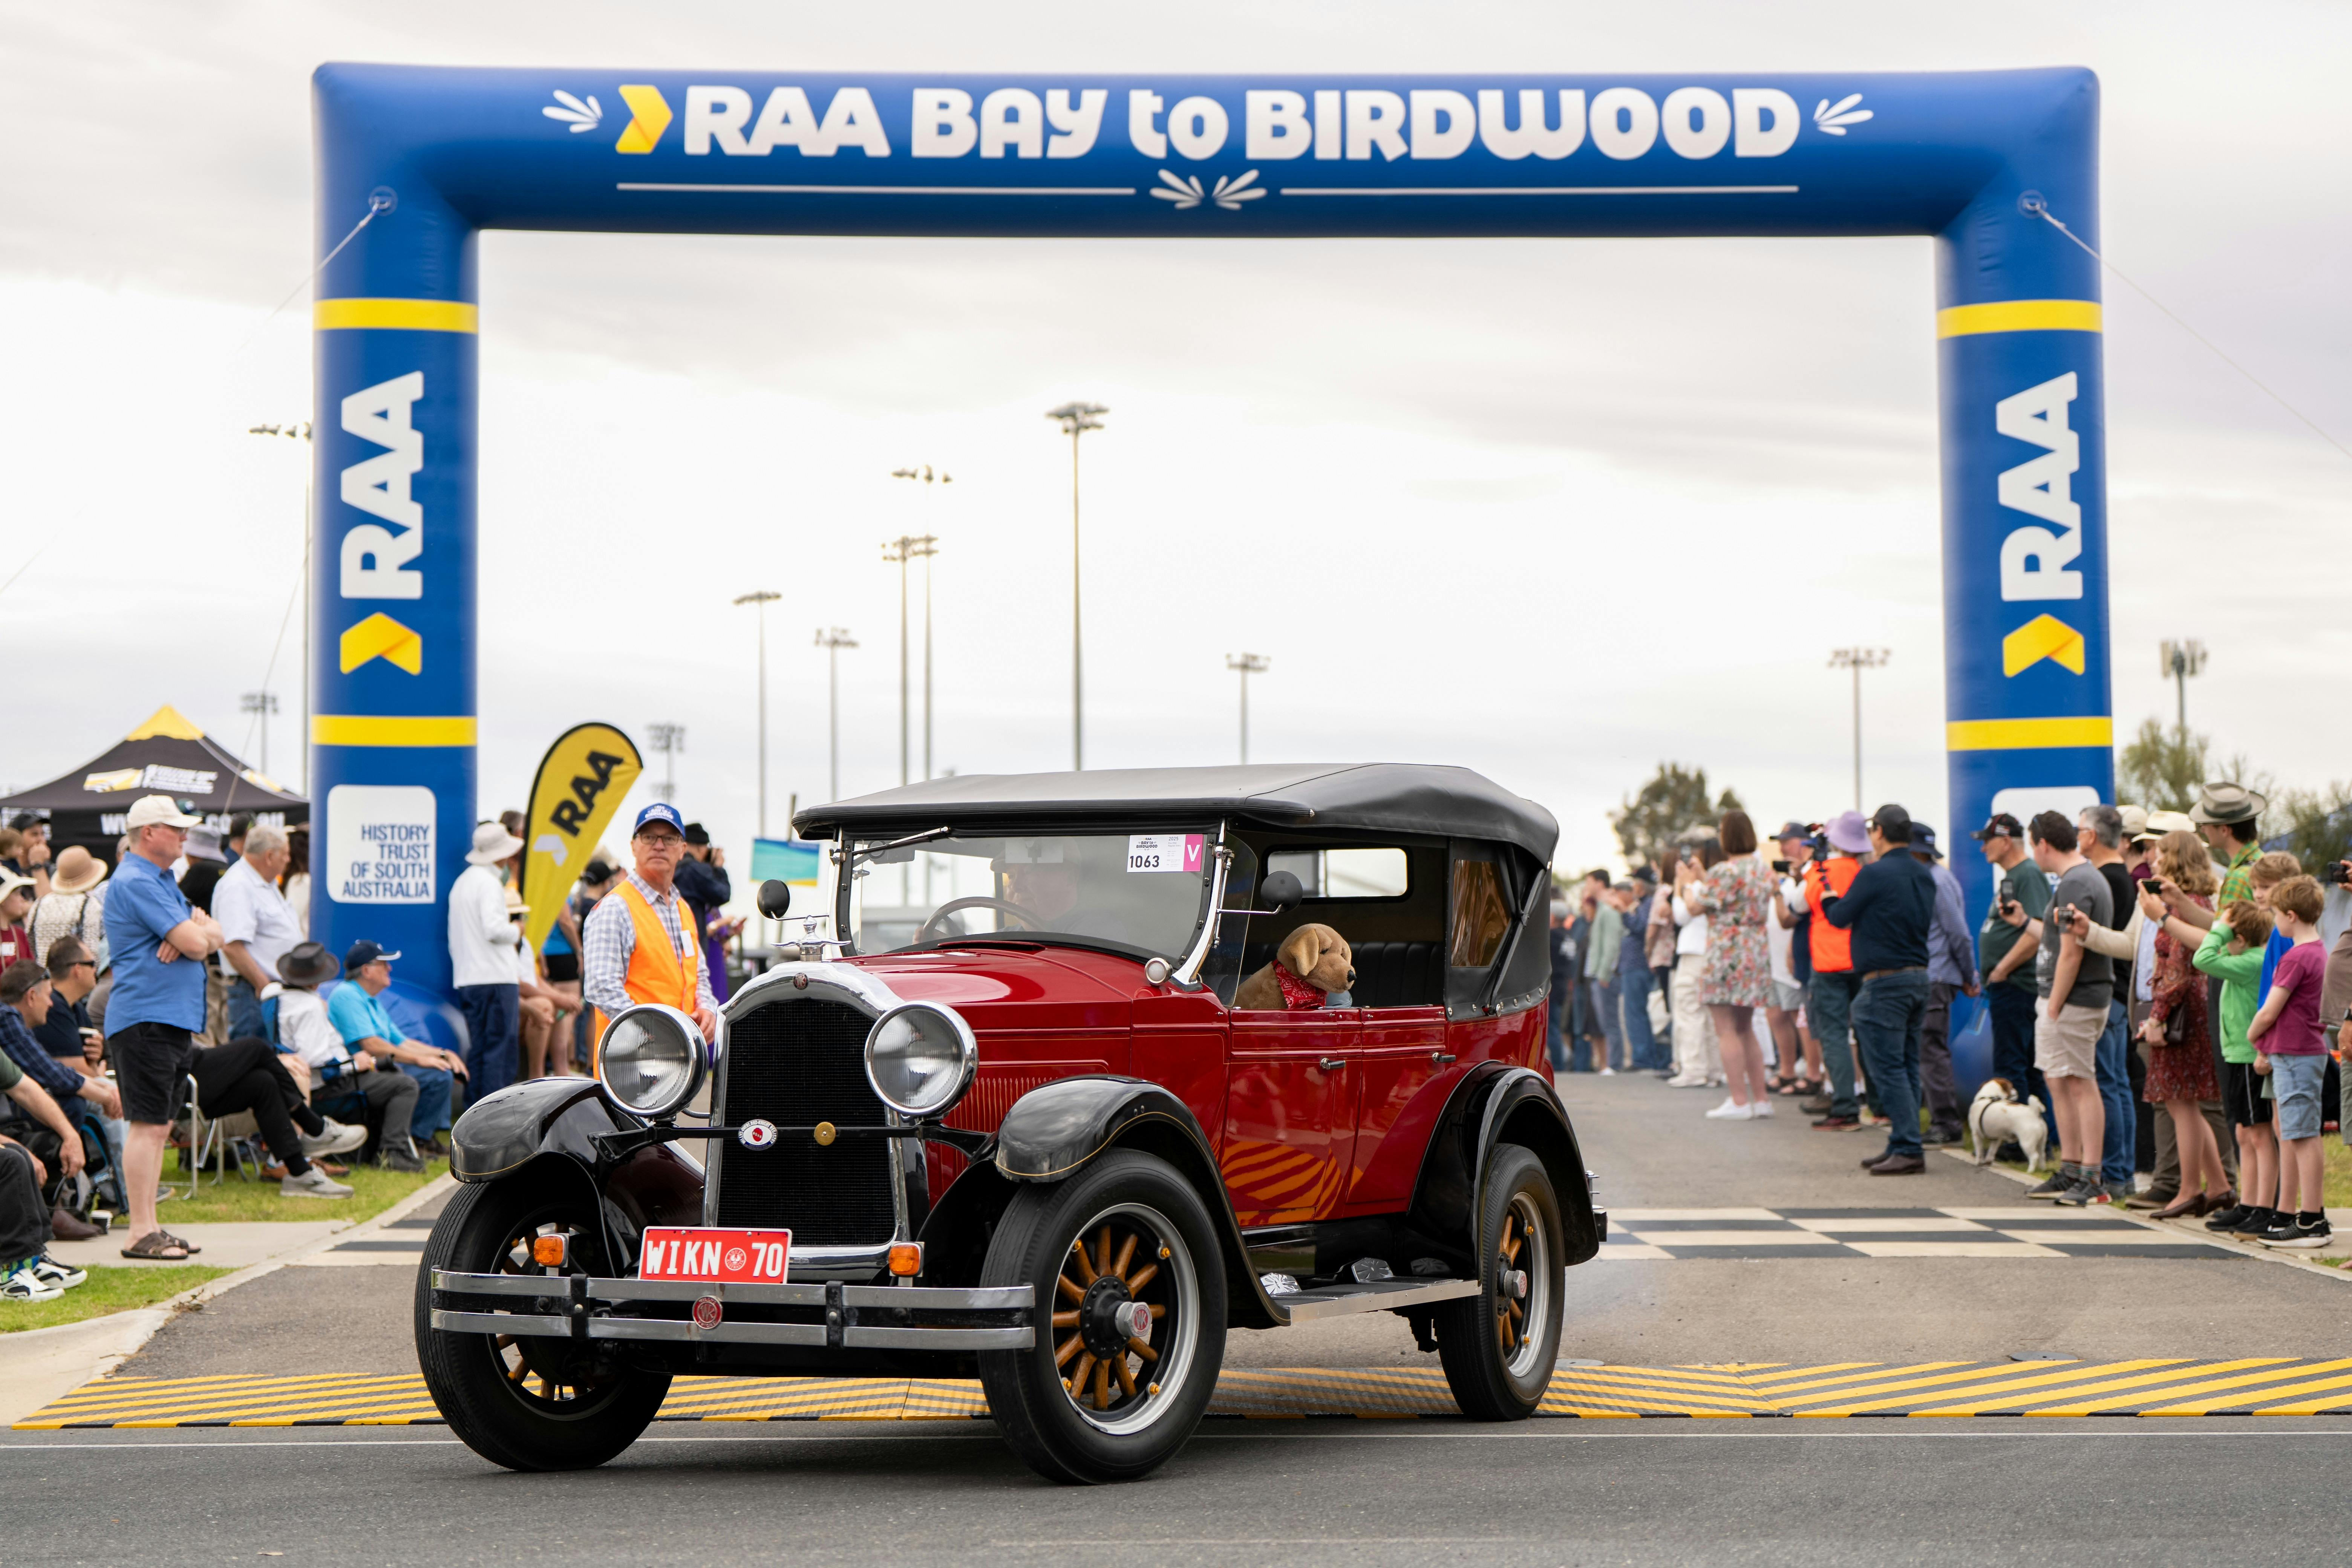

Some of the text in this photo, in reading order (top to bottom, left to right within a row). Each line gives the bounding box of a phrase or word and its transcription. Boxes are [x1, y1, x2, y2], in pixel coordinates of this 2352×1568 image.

[684, 85, 1801, 160] RAA BAY to BIRDWOOD
[340, 371, 424, 599] RAA
[1996, 371, 2083, 601] RAA
[550, 750, 624, 838] RAA
[361, 824, 429, 841] HISTORY
[378, 843, 430, 859] TRUST
[1187, 844, 1200, 862] V
[351, 862, 429, 879] OF SOUTH
[1130, 855, 1159, 868] 1063
[343, 881, 430, 898] AUSTRALIA
[646, 1240, 784, 1277] WIKN 70
